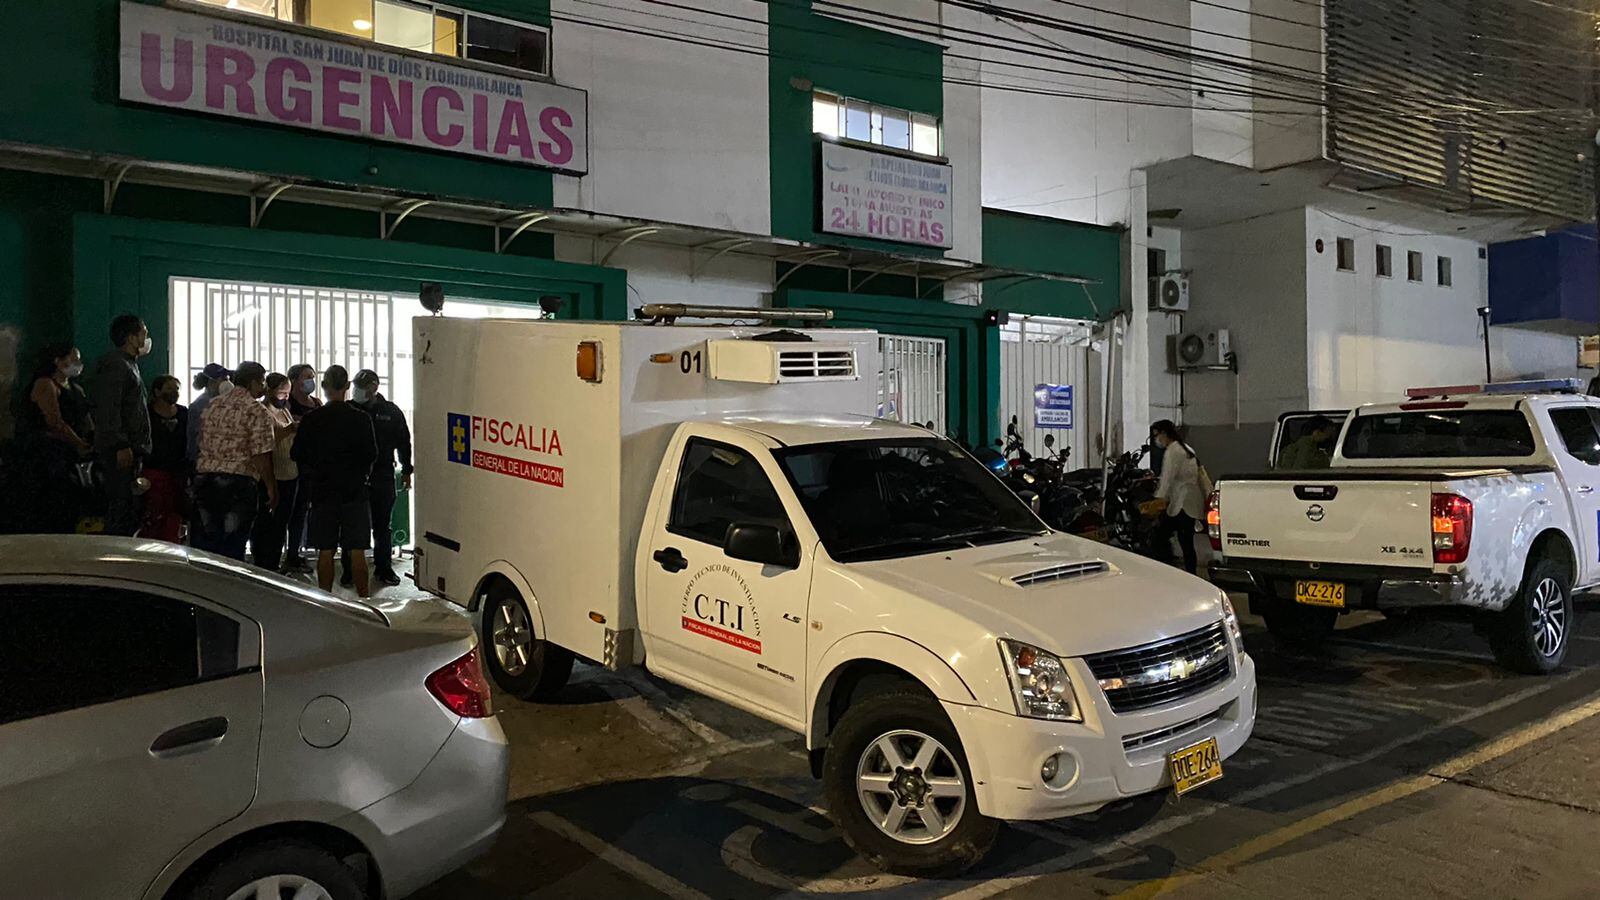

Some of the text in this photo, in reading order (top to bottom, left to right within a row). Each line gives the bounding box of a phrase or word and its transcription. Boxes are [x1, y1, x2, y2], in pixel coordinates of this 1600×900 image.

[212, 24, 288, 51] HOSPITAL
[293, 39, 324, 59] SAN
[327, 46, 364, 69] JUAN
[367, 54, 386, 73] DE
[140, 31, 574, 166] URGENCIAS
[830, 206, 944, 243] 24 HORAS
[680, 350, 701, 374] 01
[472, 415, 563, 456] FISCALIA
[473, 452, 563, 484] GENERAL DE LA NACION
[1227, 538, 1271, 548] FRONTIER
[681, 579, 695, 614] CUERPO
[694, 564, 722, 581] TECNICO
